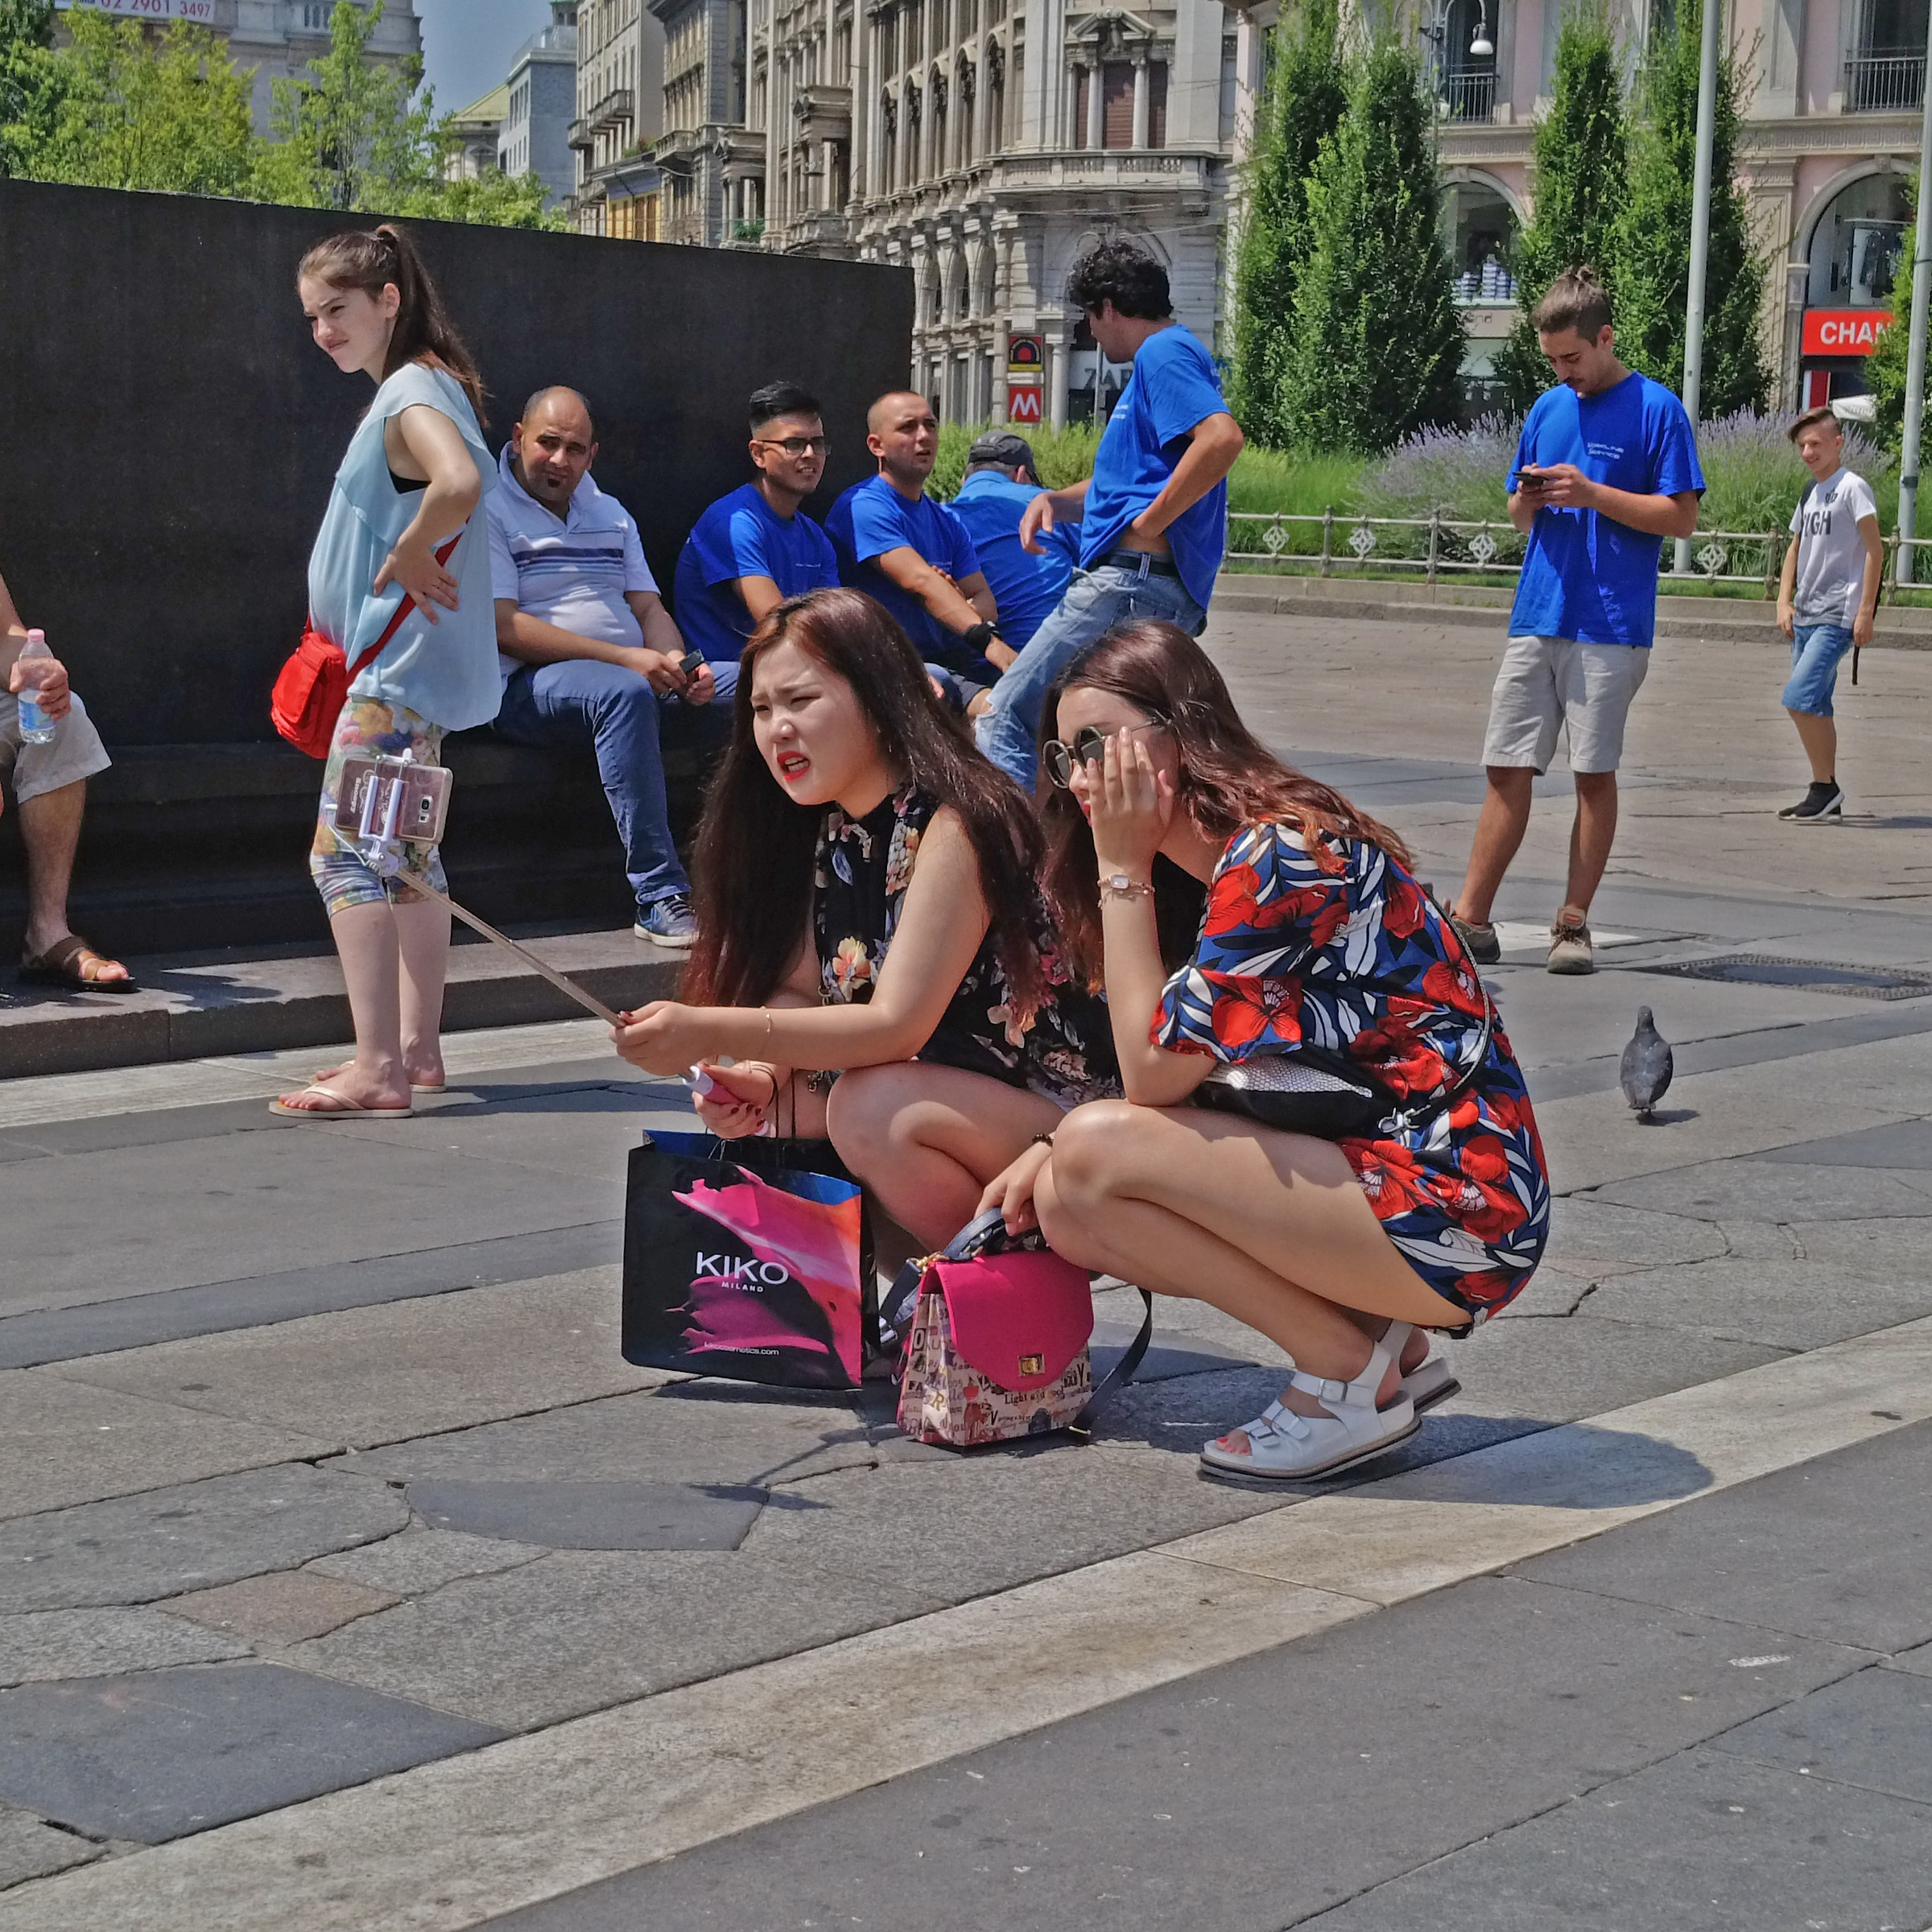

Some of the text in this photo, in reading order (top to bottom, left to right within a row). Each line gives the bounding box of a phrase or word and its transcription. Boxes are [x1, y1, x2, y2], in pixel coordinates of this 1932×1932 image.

[131, 0, 169, 14] 2901
[180, 1, 211, 18] 3497
[1010, 393, 1040, 416] M
[696, 1251, 789, 1285] KIKO
[721, 1281, 764, 1293] MILANO
